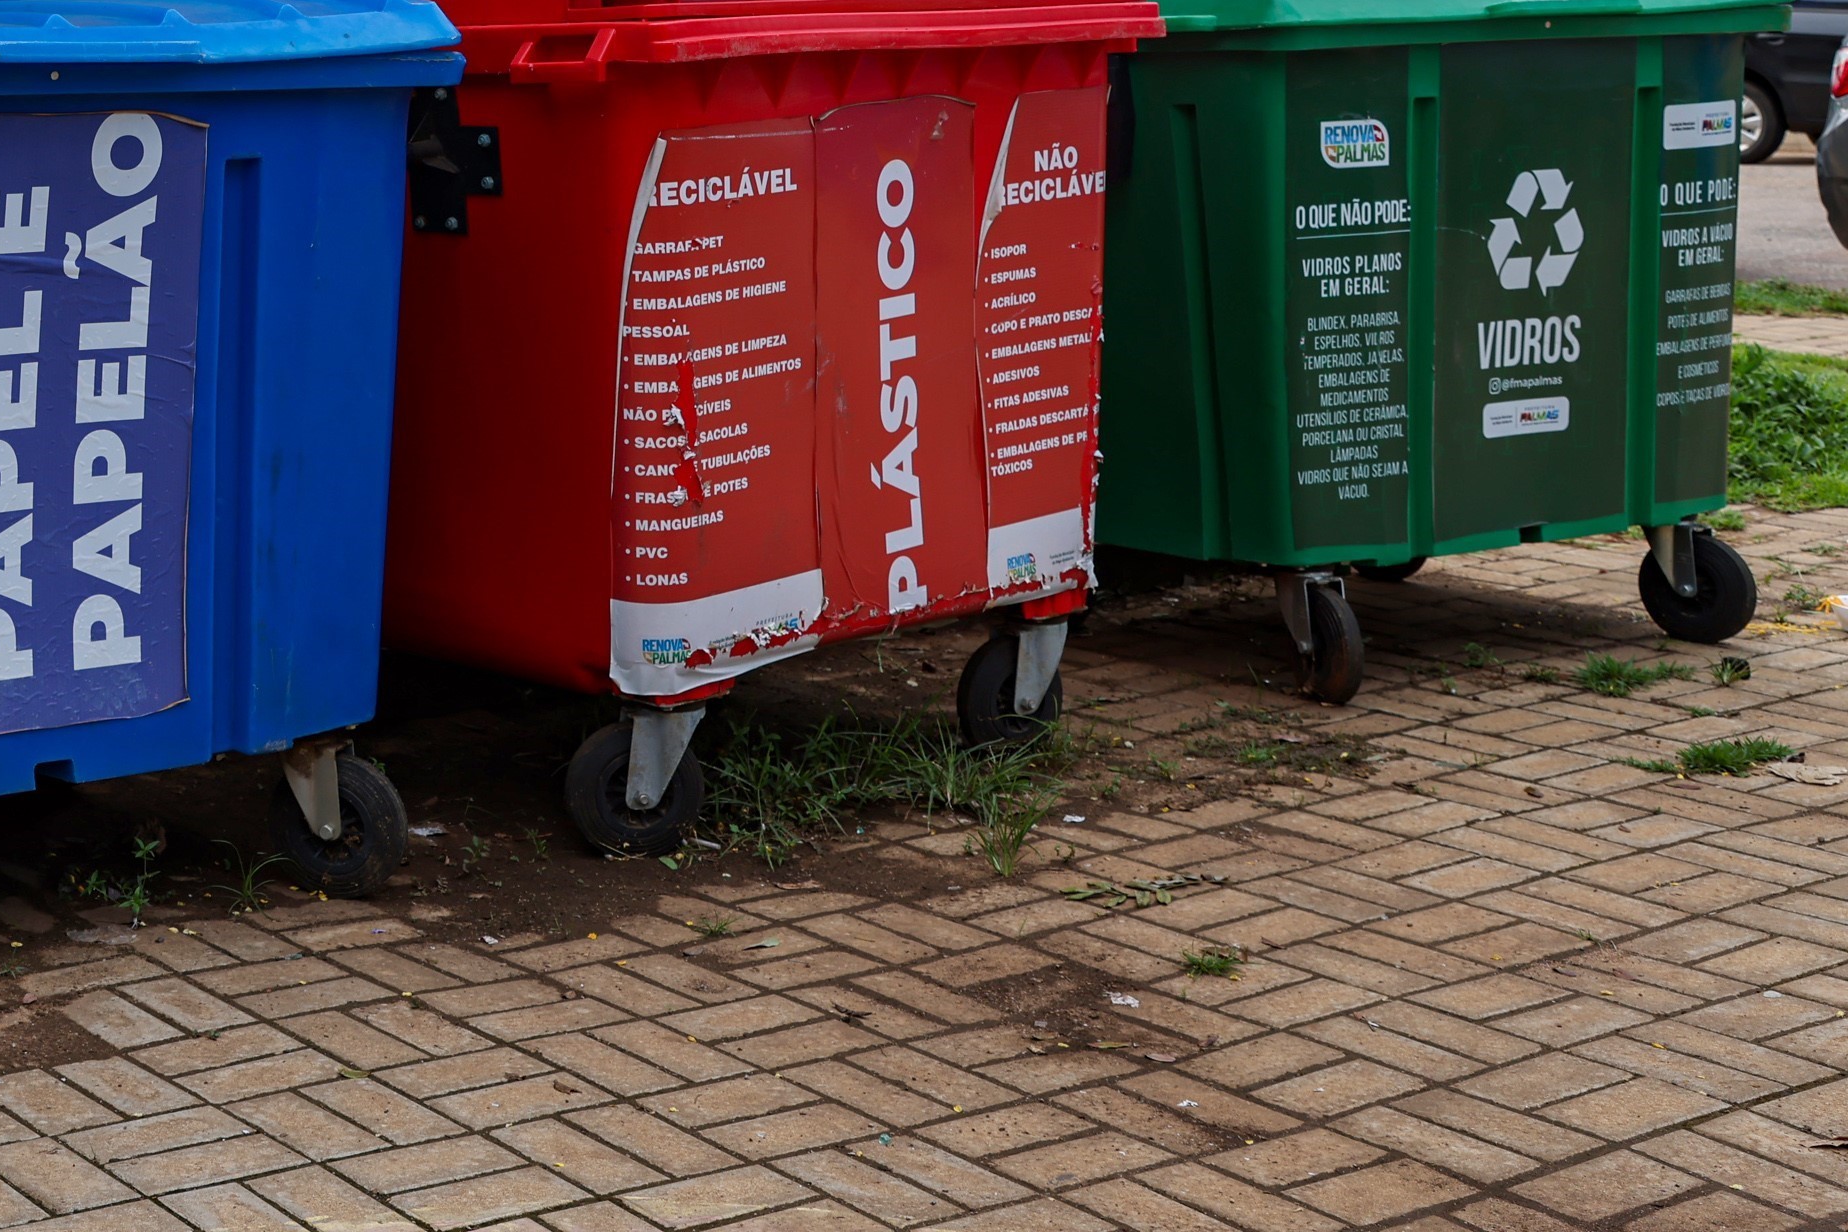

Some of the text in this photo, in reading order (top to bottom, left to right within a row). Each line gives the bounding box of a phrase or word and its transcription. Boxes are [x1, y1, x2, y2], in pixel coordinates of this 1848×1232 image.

[1325, 124, 1375, 145] RENOVA
[1034, 142, 1078, 172] NÃO
[1336, 143, 1386, 163] PALMAS
[1000, 169, 1106, 206] RECICLÁVE
[1660, 177, 1736, 206] O QUE PODE:
[1296, 198, 1412, 230] O QUE NÃO PODE:
[702, 235, 723, 249] PET
[1662, 222, 1733, 247] VIDROS A VÁCUO
[991, 244, 1027, 259] ISOPOR
[1678, 246, 1724, 267] EM GERAL:
[632, 257, 765, 283] TAMPAS DE PLÁSTICO
[1302, 252, 1402, 277] VIDROS PLANOS
[991, 267, 1036, 284] ESPUMAS
[633, 280, 787, 310] EMBALAGENS DE HIGIENE
[1321, 276, 1390, 298] EM GERAL:
[991, 291, 1036, 310] ACRÍLICO
[622, 324, 690, 338] PESSOAL
[991, 314, 1060, 334] COPO E PRATO
[725, 342, 739, 355] DE
[742, 333, 787, 353] LIMPEZA
[992, 339, 1057, 359] EMBALAGENS
[1478, 315, 1581, 370] VIDROS
[634, 358, 802, 394] EMBAGENS DE ALIMENTOS
[992, 366, 1040, 385] ADESIVOS
[1319, 368, 1390, 388] EMBALAGENS DE
[1502, 375, 1562, 391] @fmapalmas
[63, 111, 163, 670] PAPELÃO
[870, 159, 928, 614] PLÁSTICO
[994, 385, 1069, 409] FITAS ADESIVAS
[1320, 387, 1389, 407] MEDICAMENTOS
[623, 407, 657, 421] NÃO
[1297, 409, 1347, 428] UTENSÍLIOS
[1350, 409, 1361, 423] DE
[634, 422, 748, 449] SACOS SACOLAS
[996, 417, 1038, 434] FRALDAS
[1302, 424, 1404, 446] PORCELANA OU CRISTAL
[997, 434, 1075, 460] EMBALAGENS DE
[1330, 445, 1378, 463] LÂMPADAS
[701, 444, 771, 472] TUBULAÇÕES
[991, 458, 1033, 477] TÓXICOS
[1298, 460, 1408, 485] VIDROS QUE NÃO SEJAM A
[713, 477, 748, 497] POTES
[635, 510, 724, 532] MANGUEIRAS
[636, 546, 668, 559] PVC
[636, 572, 688, 586] LONAS
[642, 638, 683, 651] RENOVA
